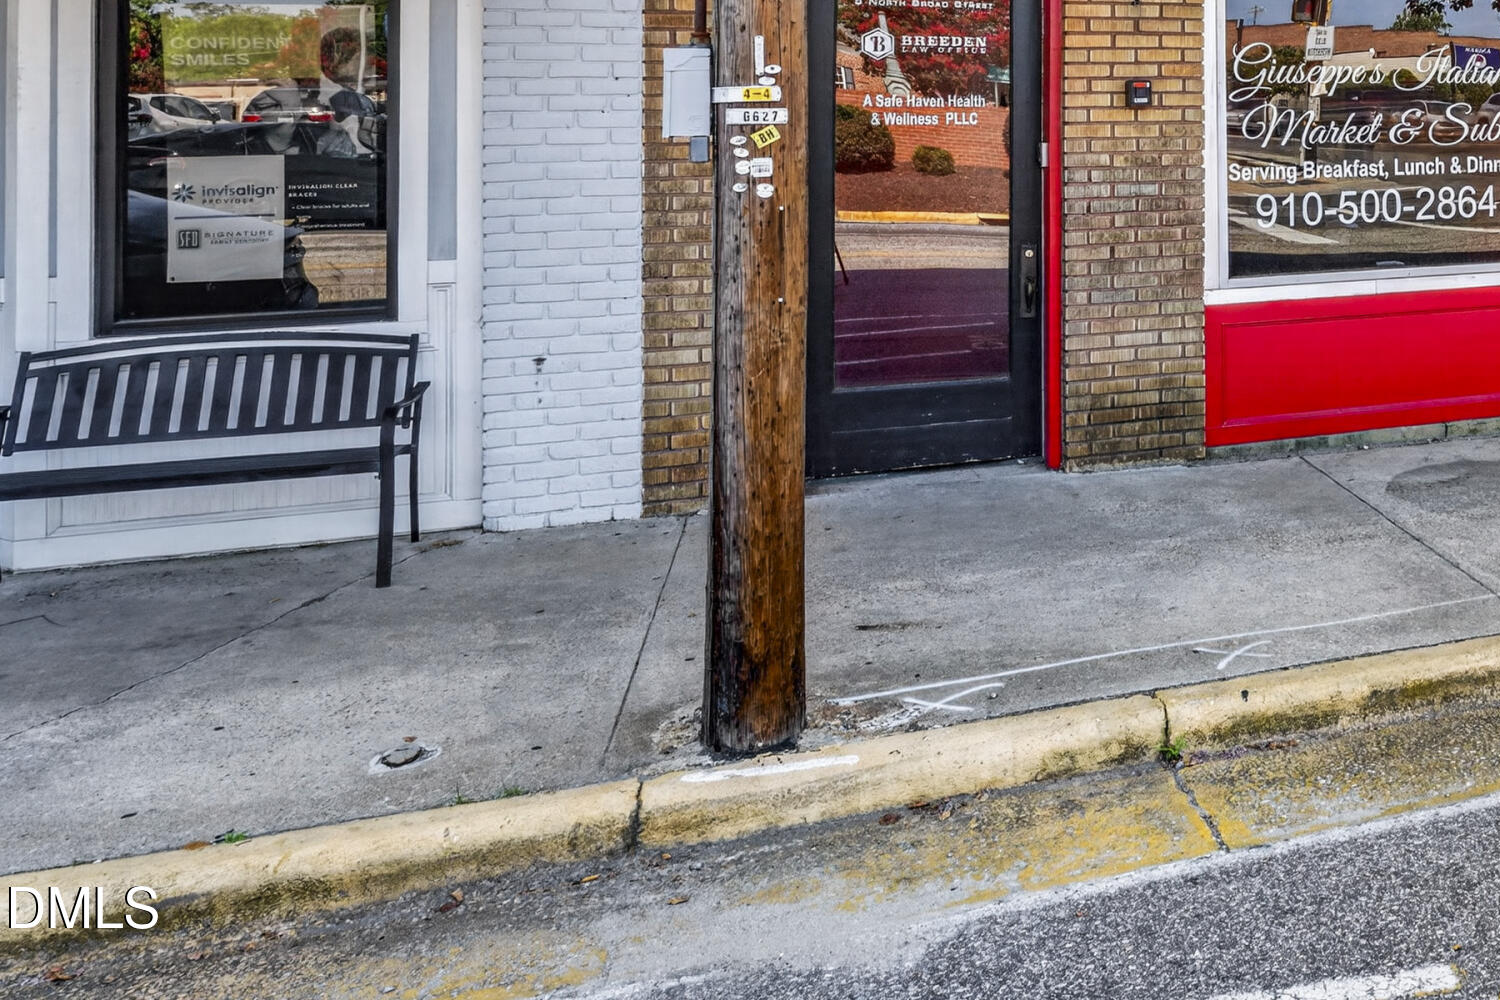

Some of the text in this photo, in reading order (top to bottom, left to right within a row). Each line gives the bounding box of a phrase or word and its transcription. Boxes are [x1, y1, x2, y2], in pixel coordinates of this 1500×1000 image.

[902, 35, 987, 48] BREEDEN
[170, 53, 249, 66] SMILES
[1229, 42, 1385, 101] Giuseppe's
[863, 94, 986, 108] A Safe Haven Health
[870, 112, 978, 126] & Wellness PLLC
[1241, 102, 1382, 149] Market
[1389, 108, 1424, 145] &
[1228, 163, 1297, 183] Serving
[1303, 159, 1388, 180] Breakfast,
[1394, 157, 1444, 176] Lunch
[1450, 157, 1463, 175] &
[201, 184, 275, 198] invisalign
[1255, 184, 1497, 229] 910-500-2864
[204, 230, 274, 239] SIGNATURE
